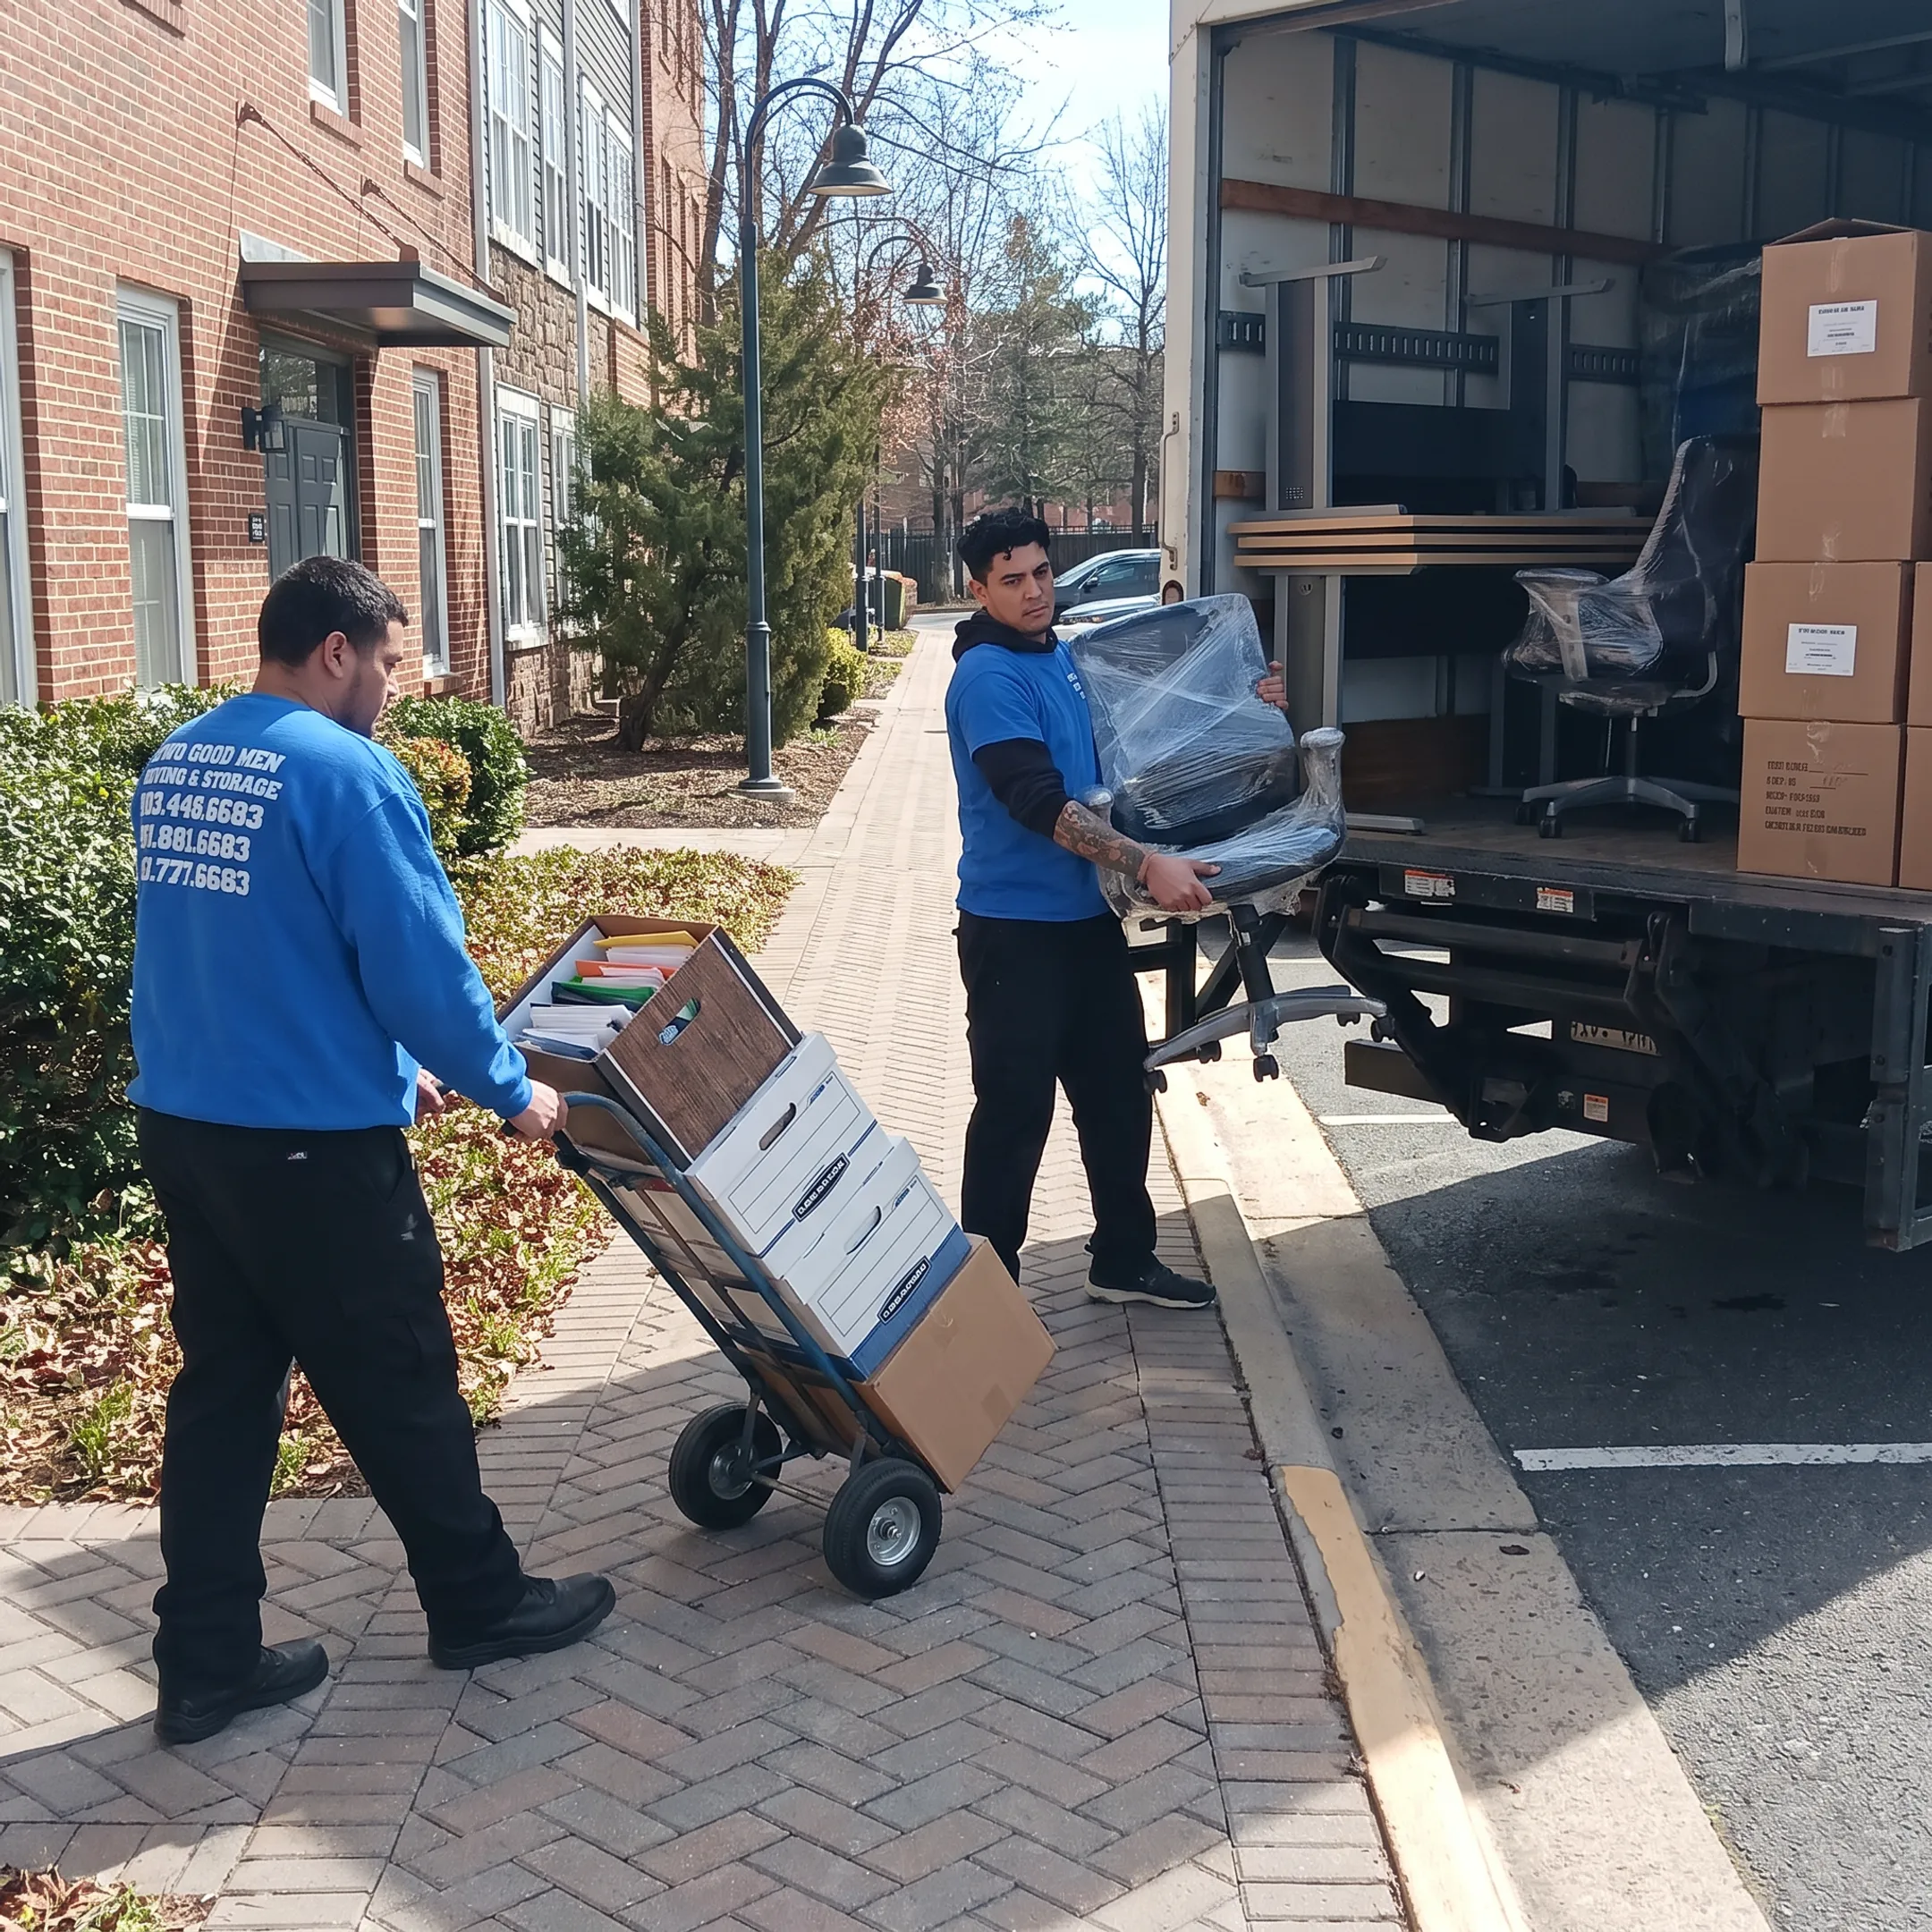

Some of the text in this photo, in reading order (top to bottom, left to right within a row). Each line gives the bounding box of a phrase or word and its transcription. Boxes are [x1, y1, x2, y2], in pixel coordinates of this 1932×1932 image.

[188, 743, 236, 767] GOOD
[234, 748, 286, 774] MEN
[188, 769, 199, 787] &
[201, 770, 284, 801] STORAGE
